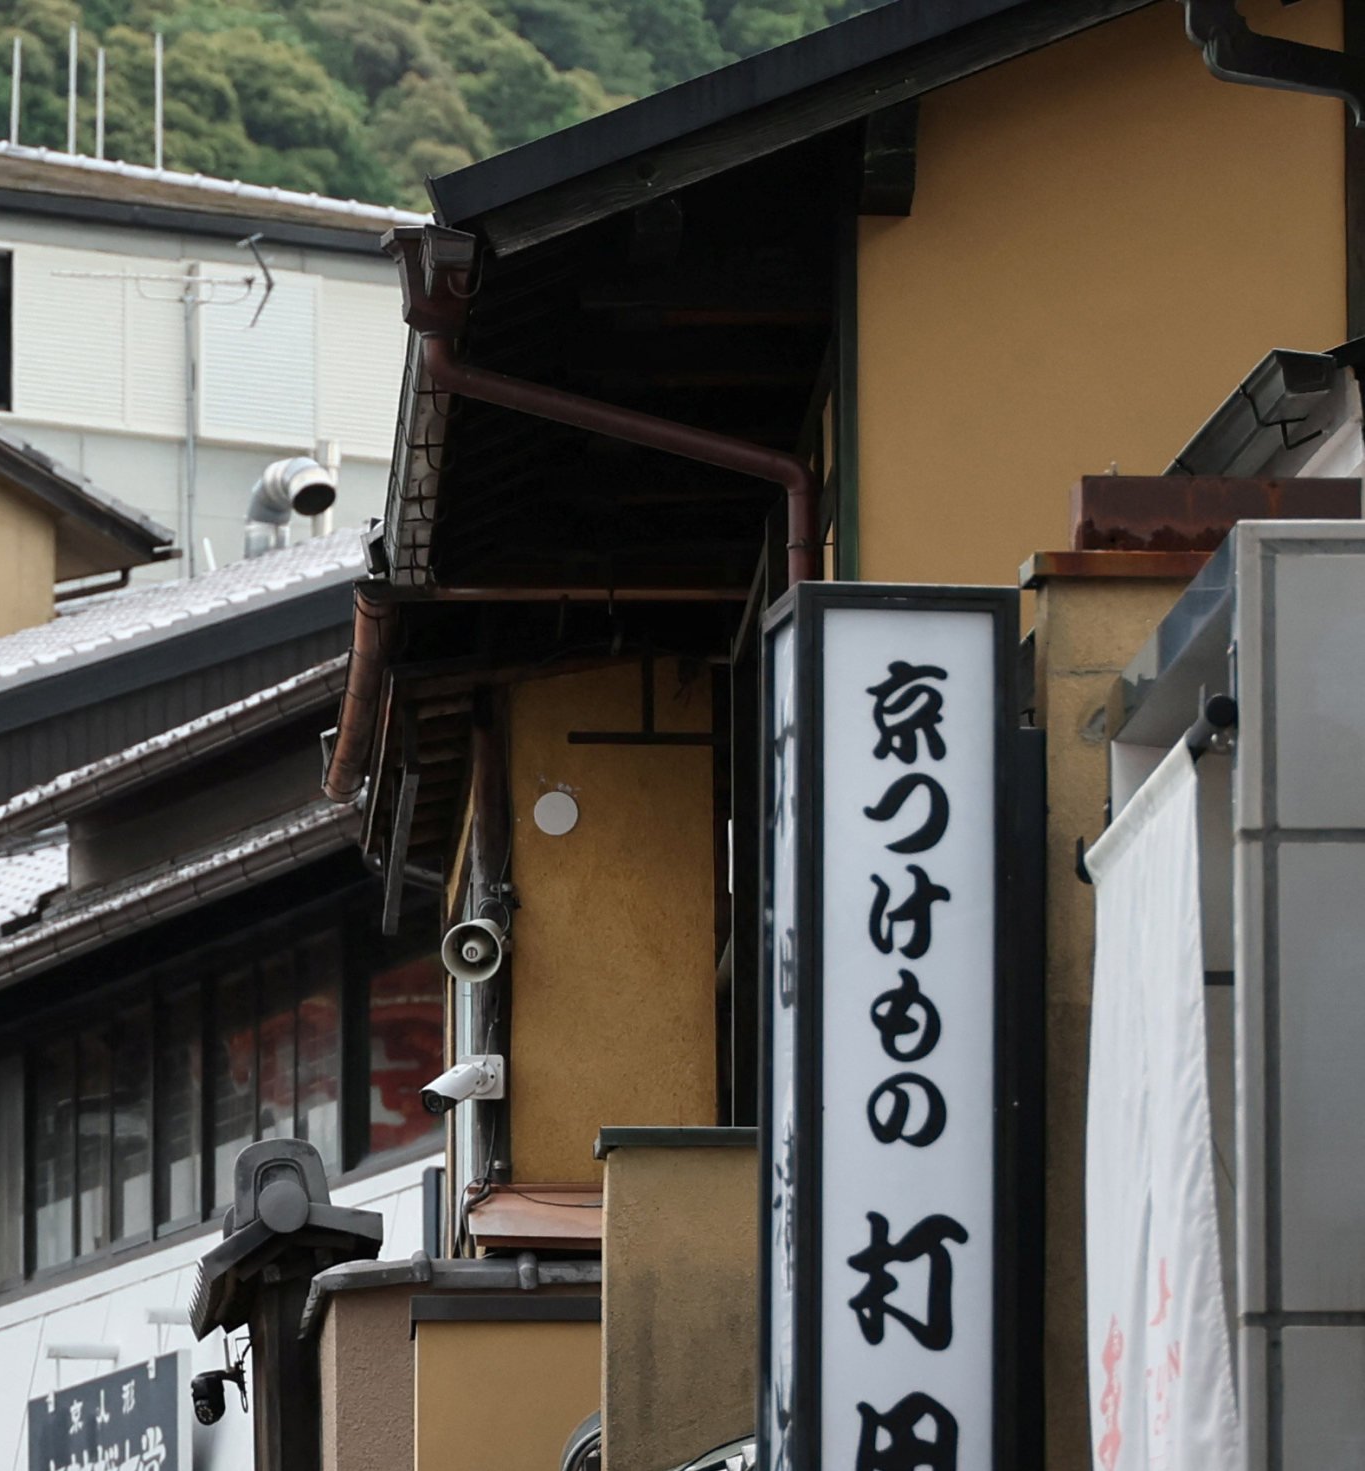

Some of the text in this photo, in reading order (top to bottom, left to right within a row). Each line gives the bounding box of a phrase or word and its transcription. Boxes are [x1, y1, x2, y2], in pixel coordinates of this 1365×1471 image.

[863, 660, 952, 1148] 京つけもの
[68, 1379, 136, 1435] 京人形
